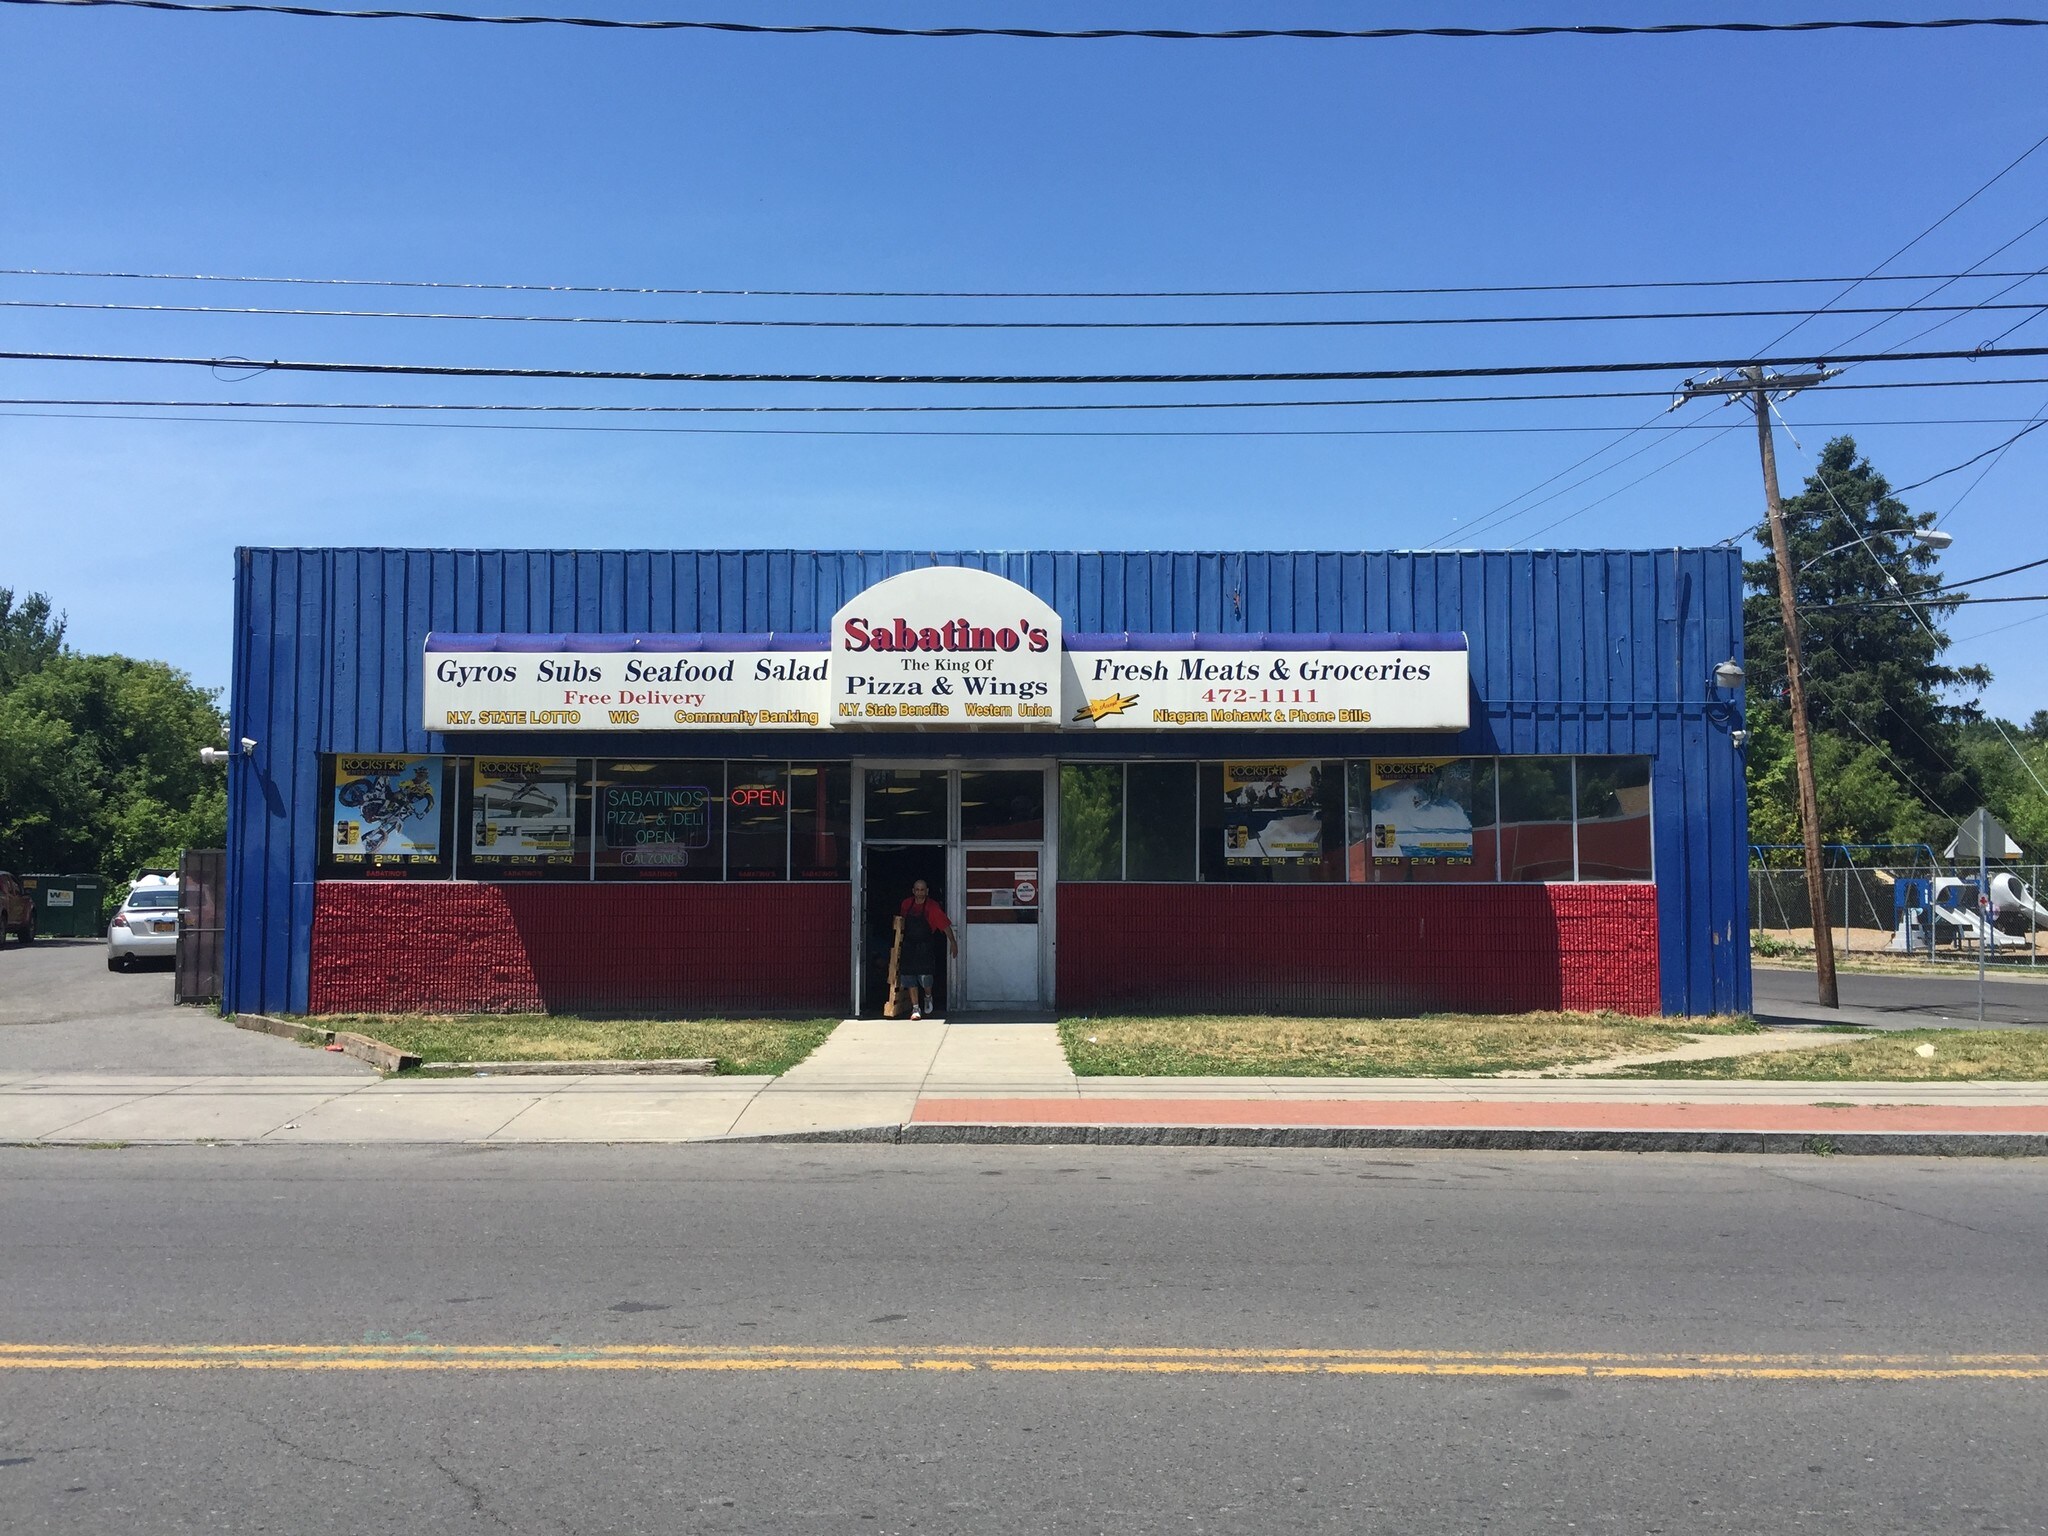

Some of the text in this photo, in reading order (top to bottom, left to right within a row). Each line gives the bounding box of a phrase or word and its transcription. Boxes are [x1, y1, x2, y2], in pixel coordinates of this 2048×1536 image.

[845, 618, 1049, 652] Sabatino's
[437, 658, 828, 687] Gyros Subs Seafood Salad
[901, 659, 995, 673] The King Of
[1092, 658, 1431, 680] Fresh Meats & Groceries
[846, 676, 1048, 700] Pizza & Wings
[1202, 689, 1318, 702] 472-1111
[564, 691, 705, 707] Free Delivery
[839, 703, 949, 716] N.Y. State Benefits
[965, 703, 1052, 717] Western Union
[1153, 709, 1371, 724] Niagara Mohawk & Phone Bills
[447, 711, 581, 724] N.Y. STATE LOTTO
[609, 711, 640, 724] WIC
[674, 710, 819, 726] Community Banking
[608, 790, 704, 807] SABATINOS
[731, 790, 785, 806] OPEN
[607, 811, 704, 826] PIZZA & DELI
[635, 830, 676, 844] OPEN
[624, 852, 684, 865] CALZONES
